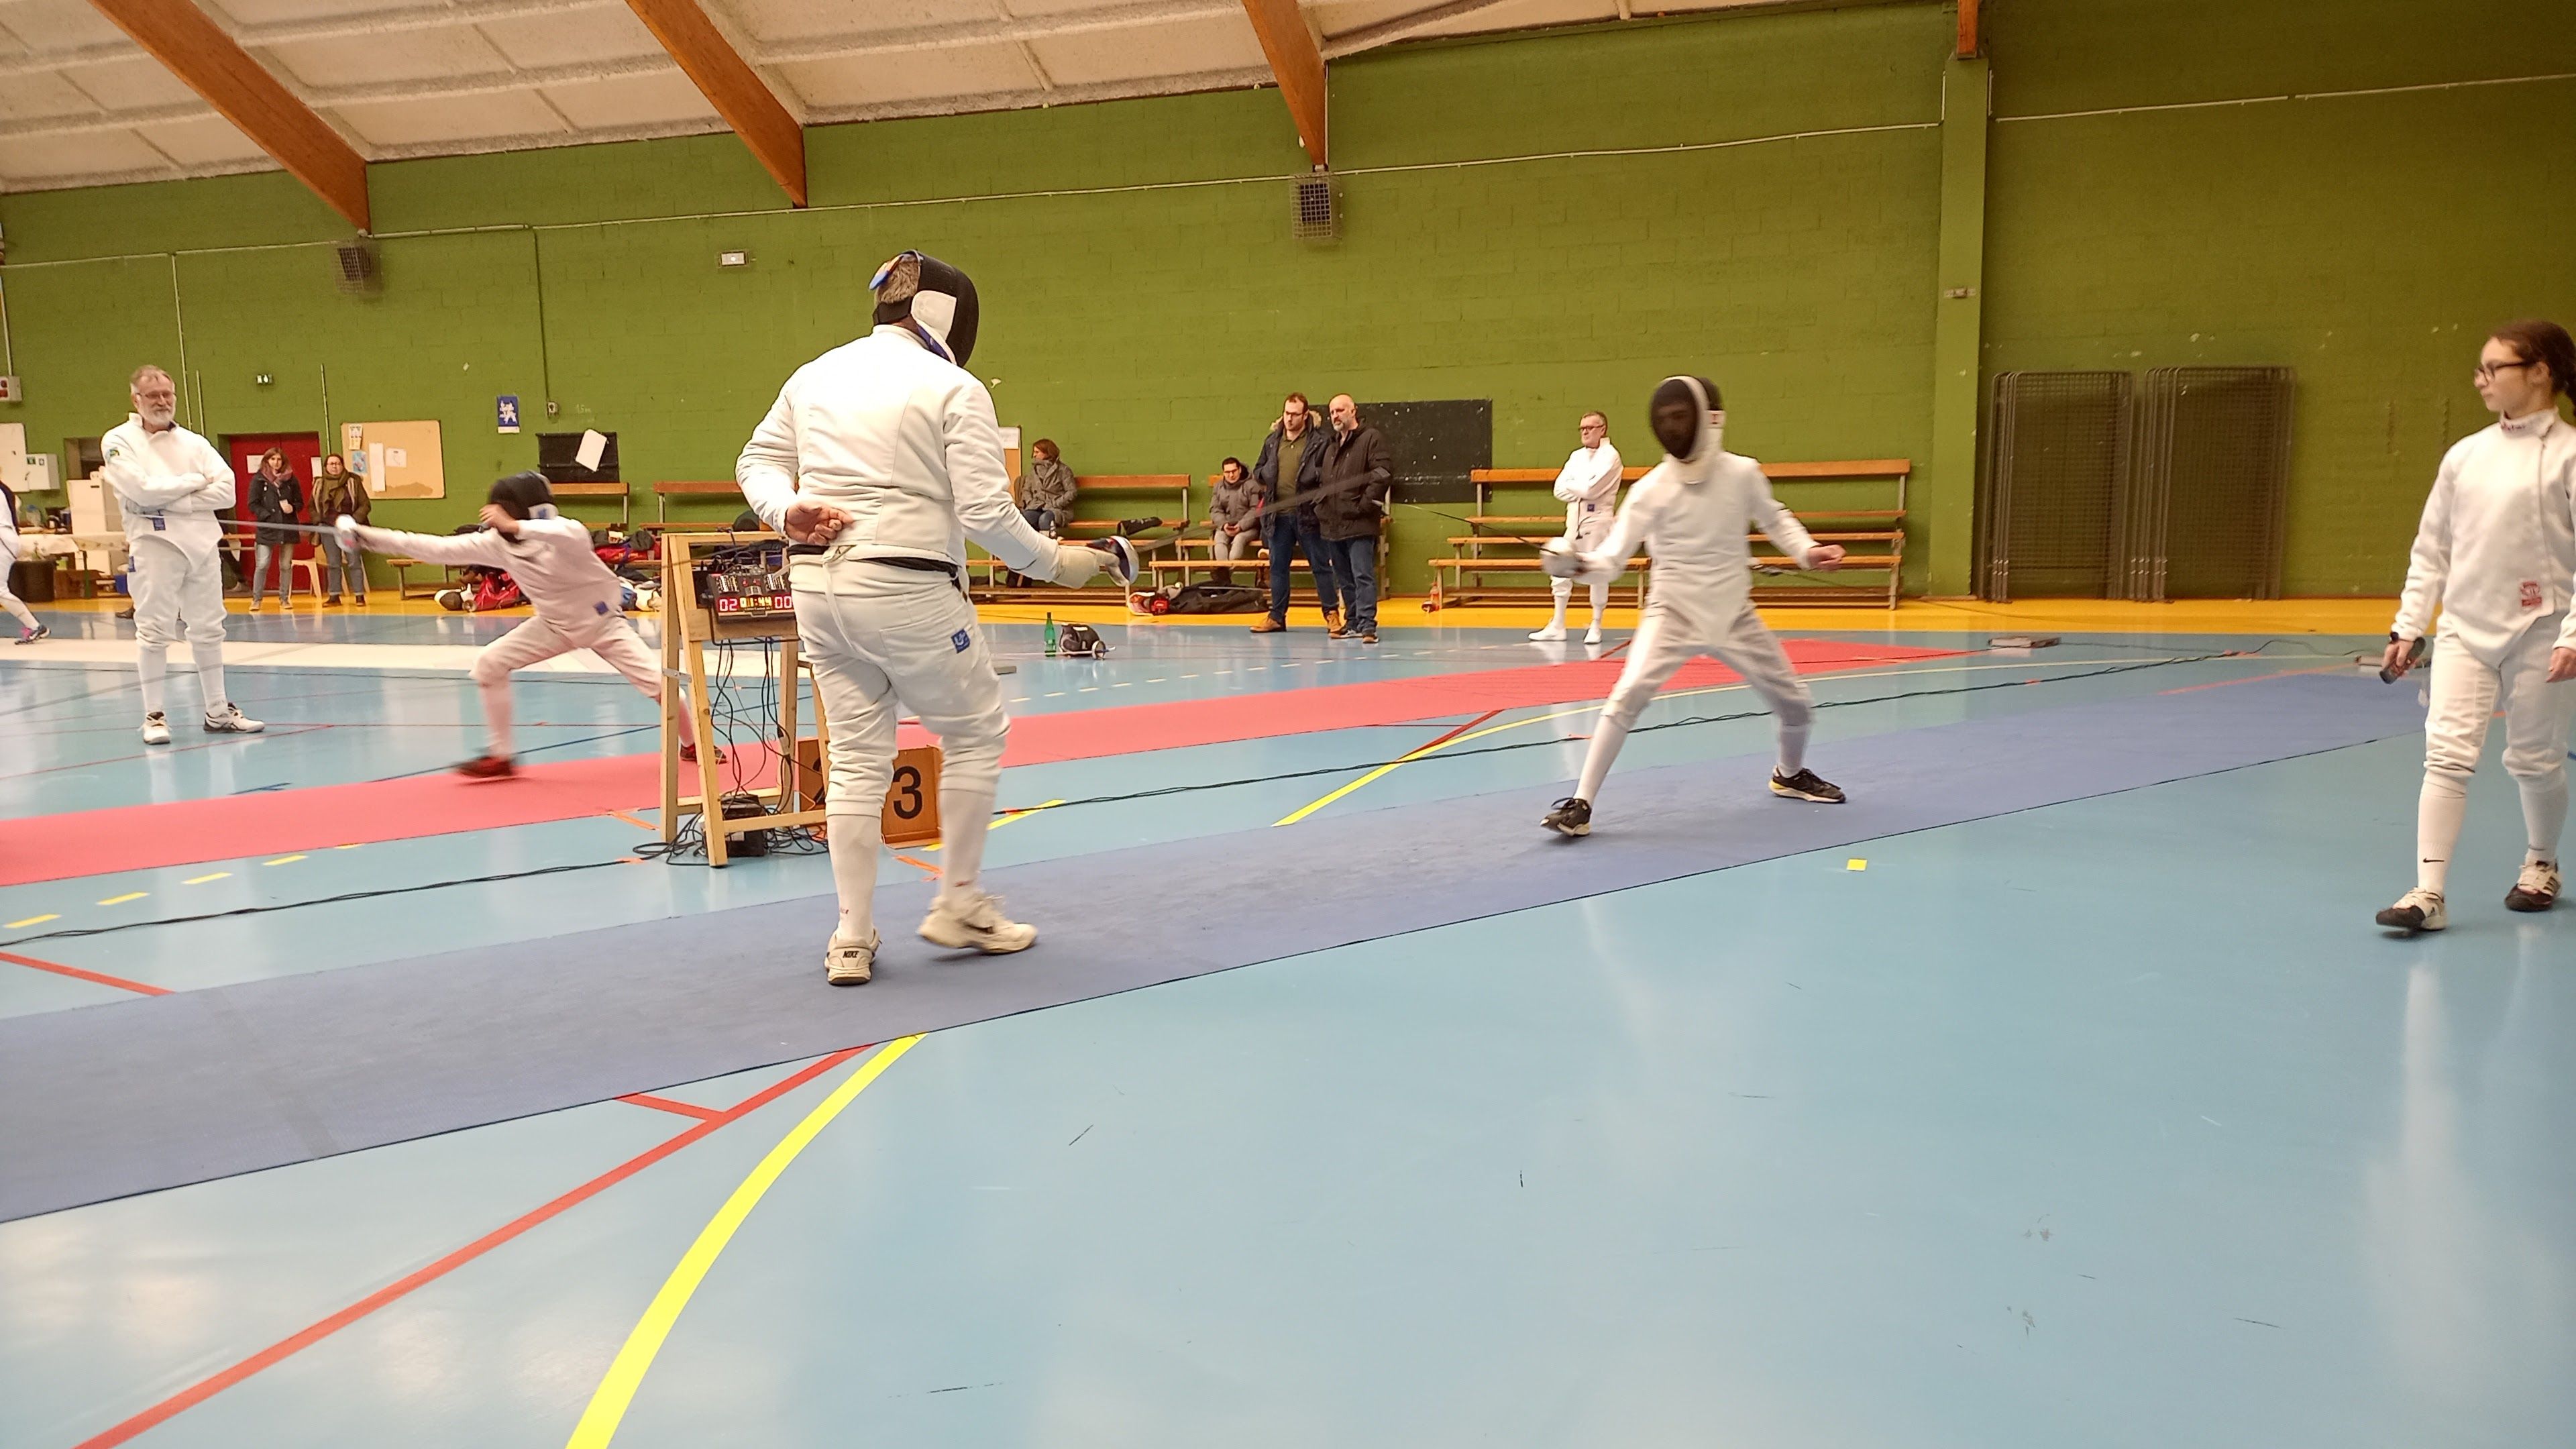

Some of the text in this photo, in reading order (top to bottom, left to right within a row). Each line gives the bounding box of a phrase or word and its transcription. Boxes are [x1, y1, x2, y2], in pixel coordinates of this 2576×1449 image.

[719, 598, 738, 612] 02
[774, 596, 792, 608] 00
[893, 765, 923, 820] 3
